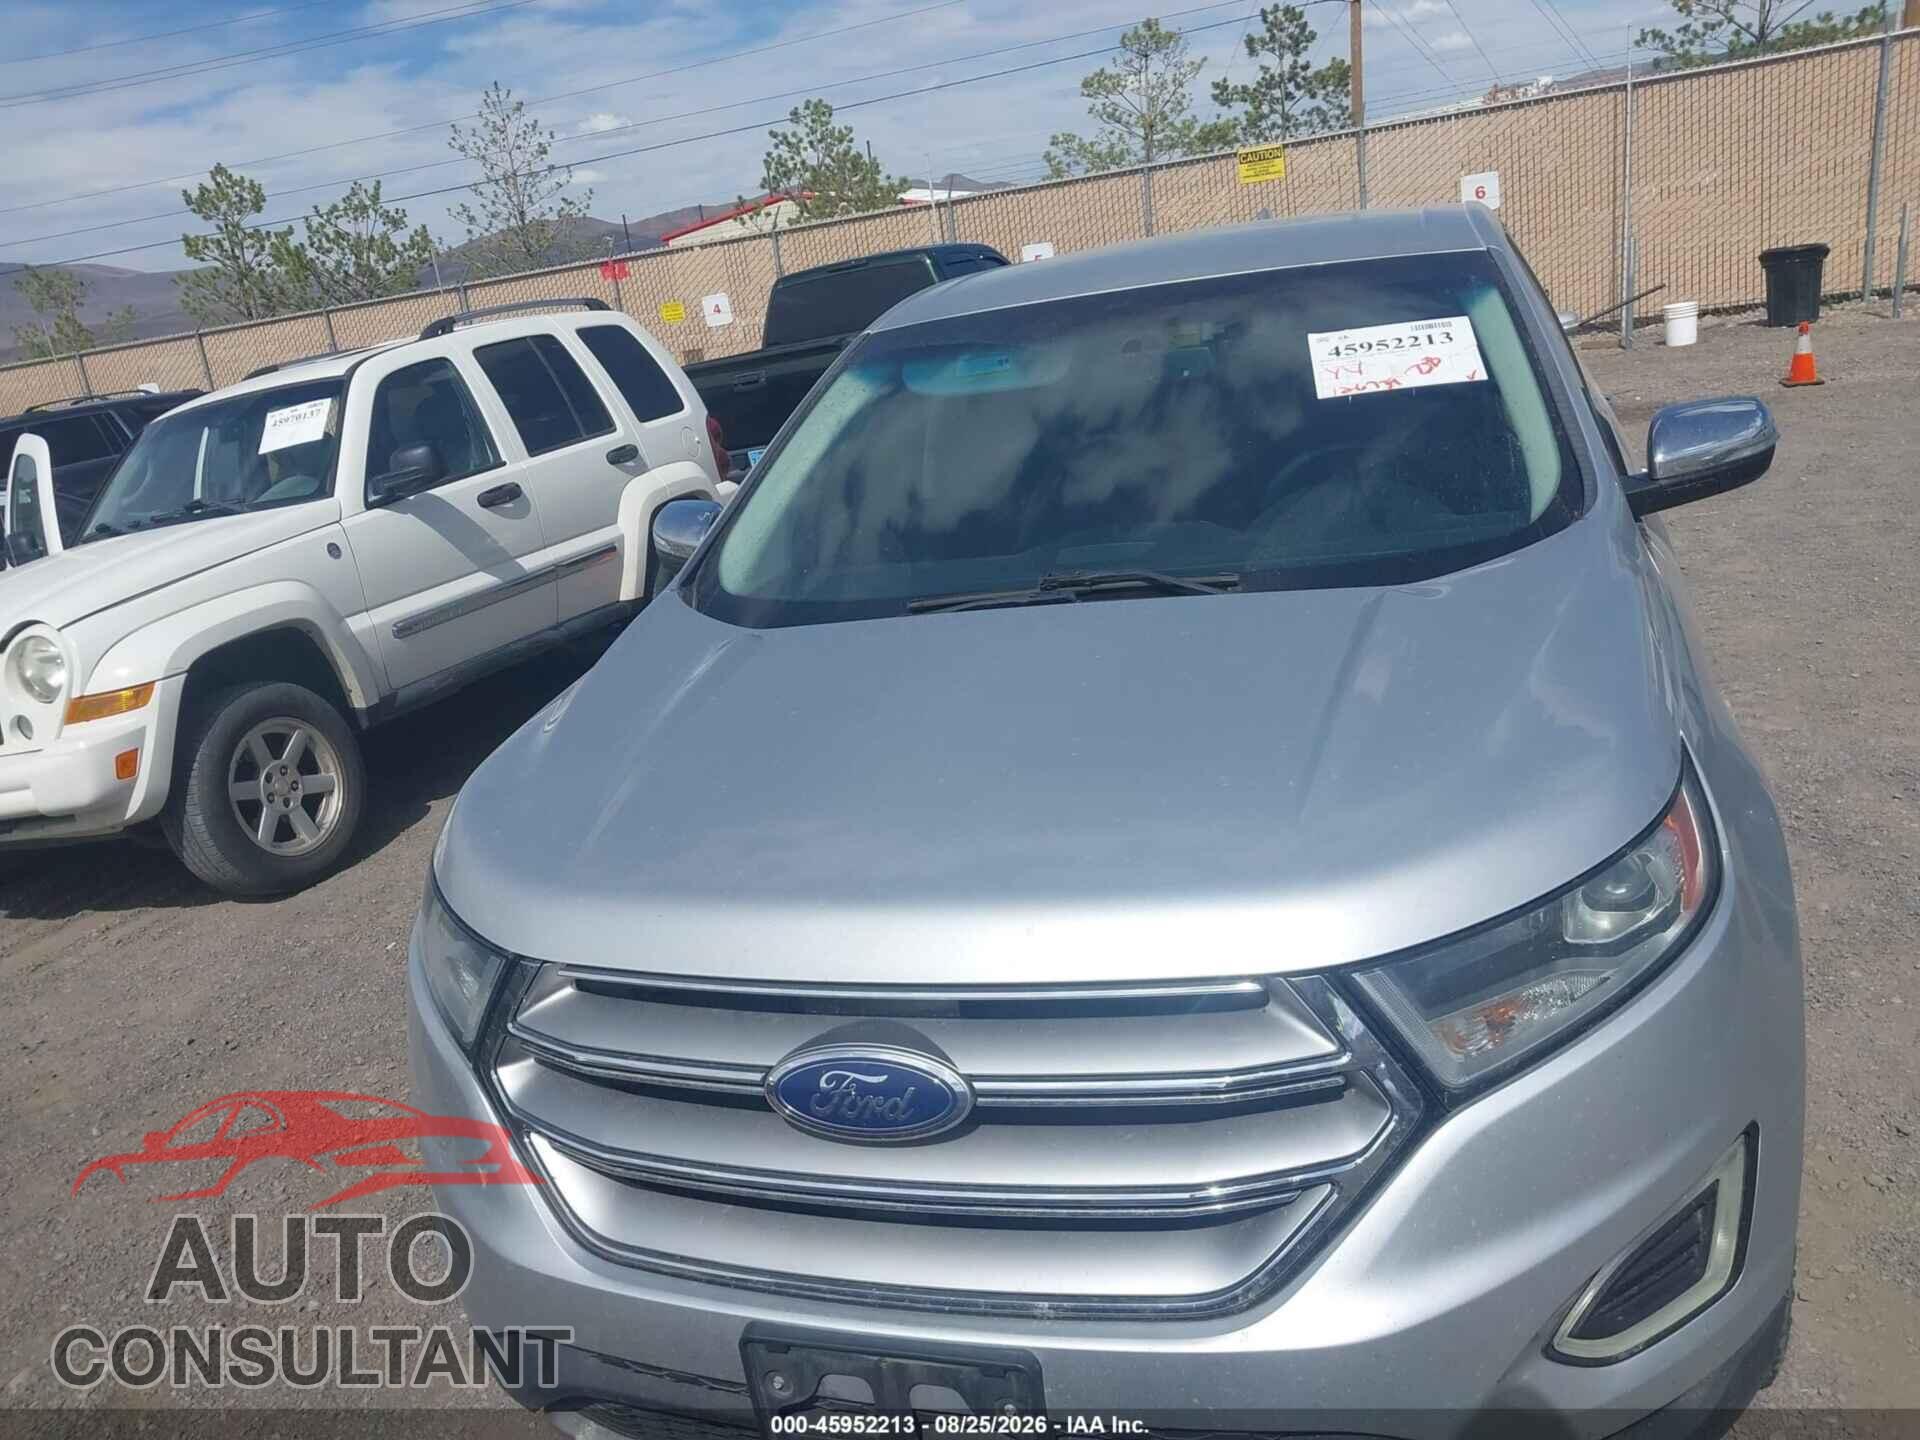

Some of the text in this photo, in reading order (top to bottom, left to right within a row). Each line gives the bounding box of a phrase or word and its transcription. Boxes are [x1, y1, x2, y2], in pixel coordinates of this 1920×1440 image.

[1240, 148, 1281, 163] CAUTION
[1474, 185, 1486, 200] 6
[712, 303, 722, 315] 4
[1327, 331, 1454, 357] 45952213
[809, 1070, 918, 1121] Ford
